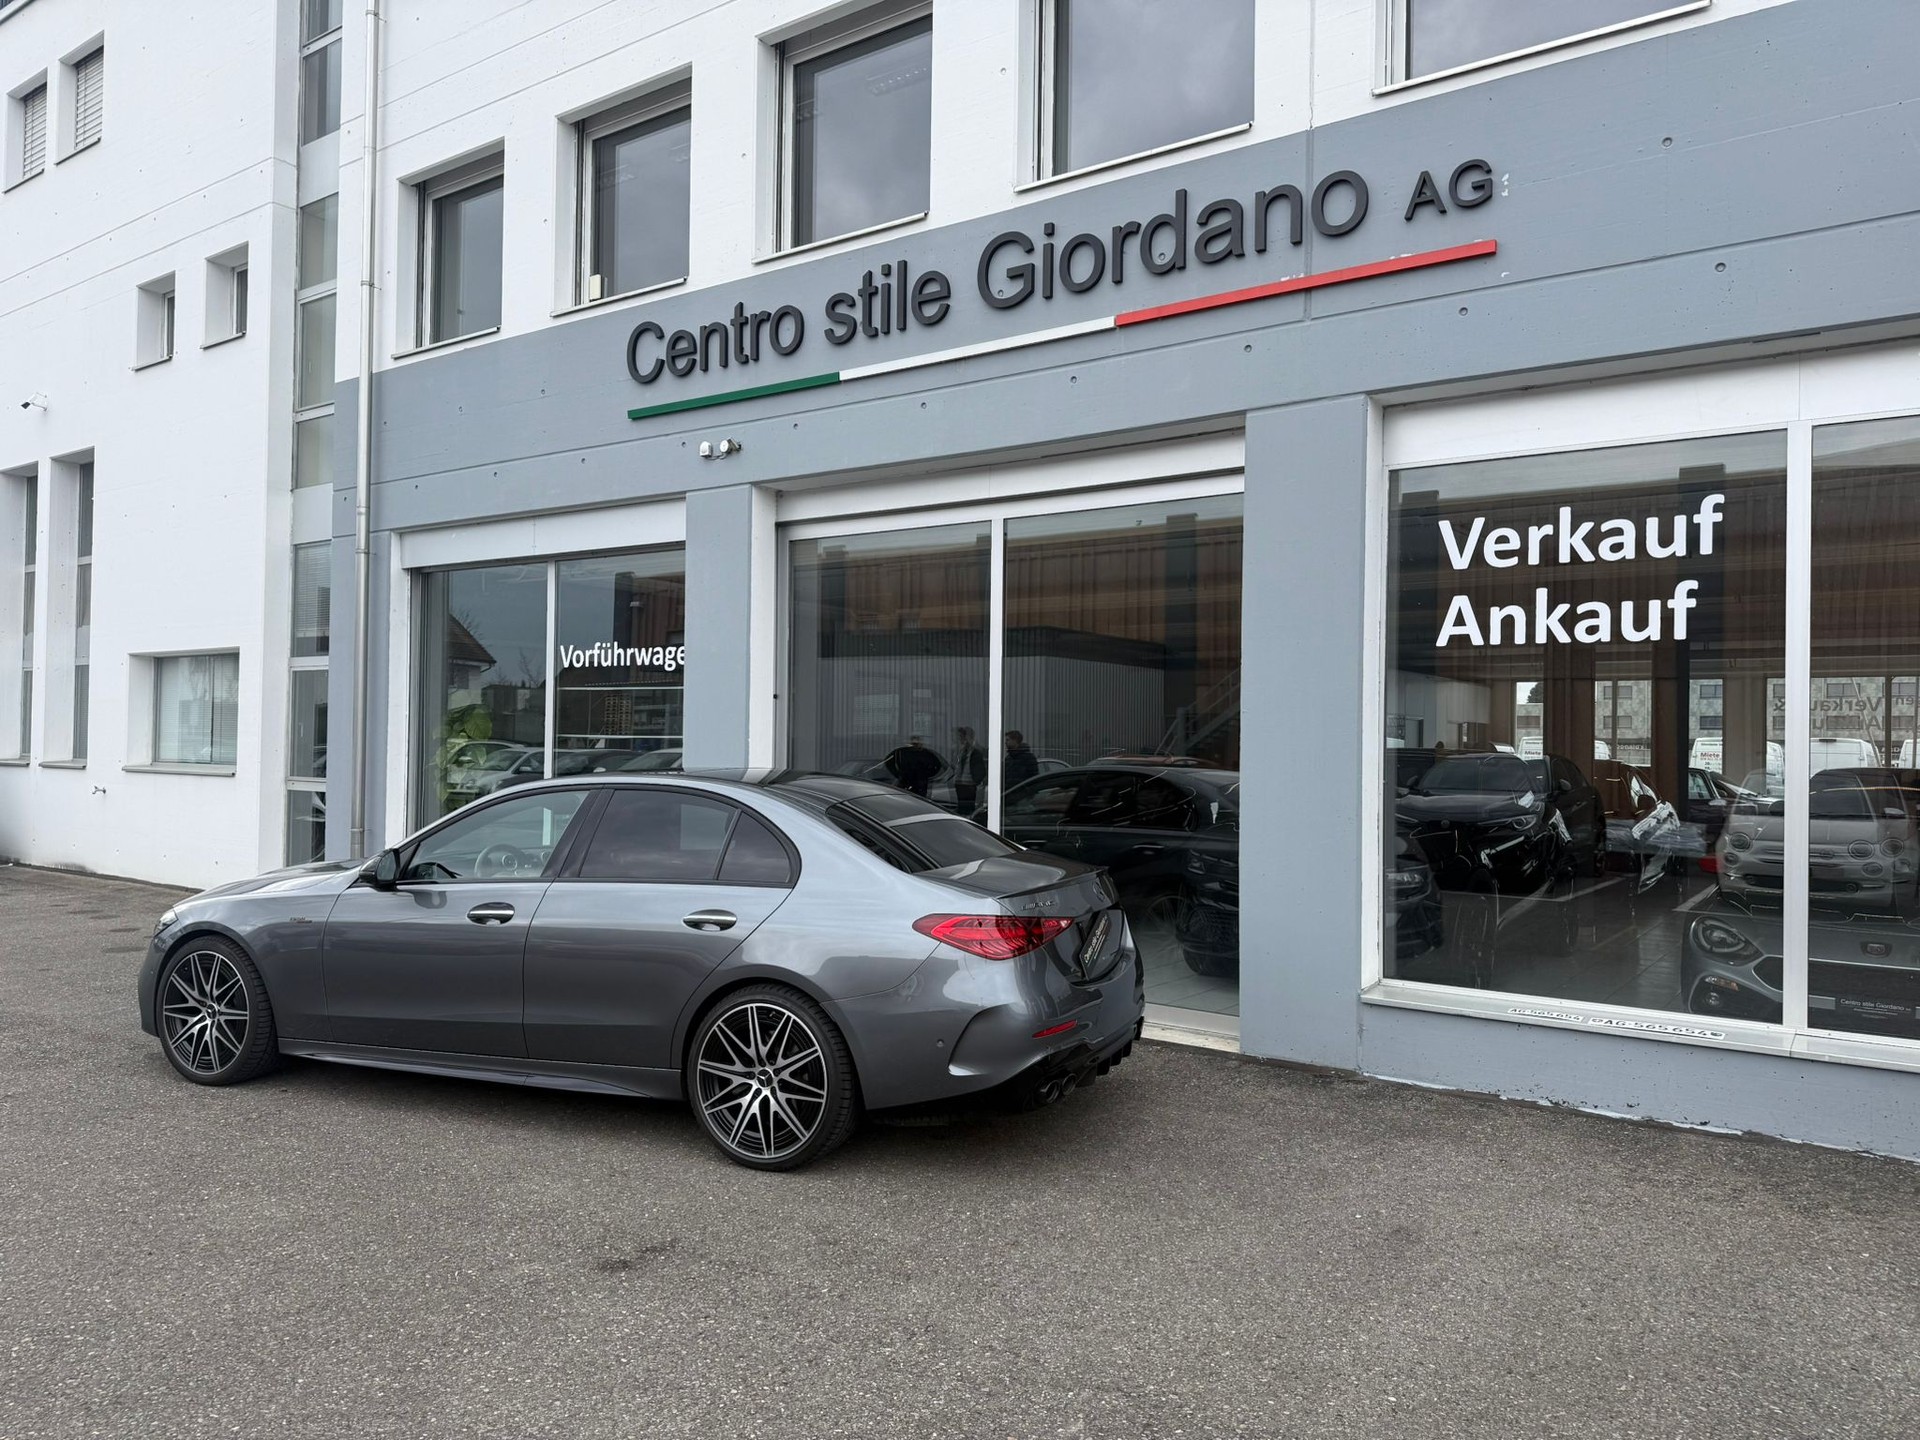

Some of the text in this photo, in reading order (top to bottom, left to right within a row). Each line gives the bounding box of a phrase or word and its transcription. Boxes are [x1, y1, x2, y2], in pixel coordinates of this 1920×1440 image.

[626, 158, 1494, 384] Centro stile Giordano AG
[1438, 493, 1726, 571] Verkauf
[1435, 579, 1699, 648] Ankauf
[560, 641, 685, 671] Vorführwage
